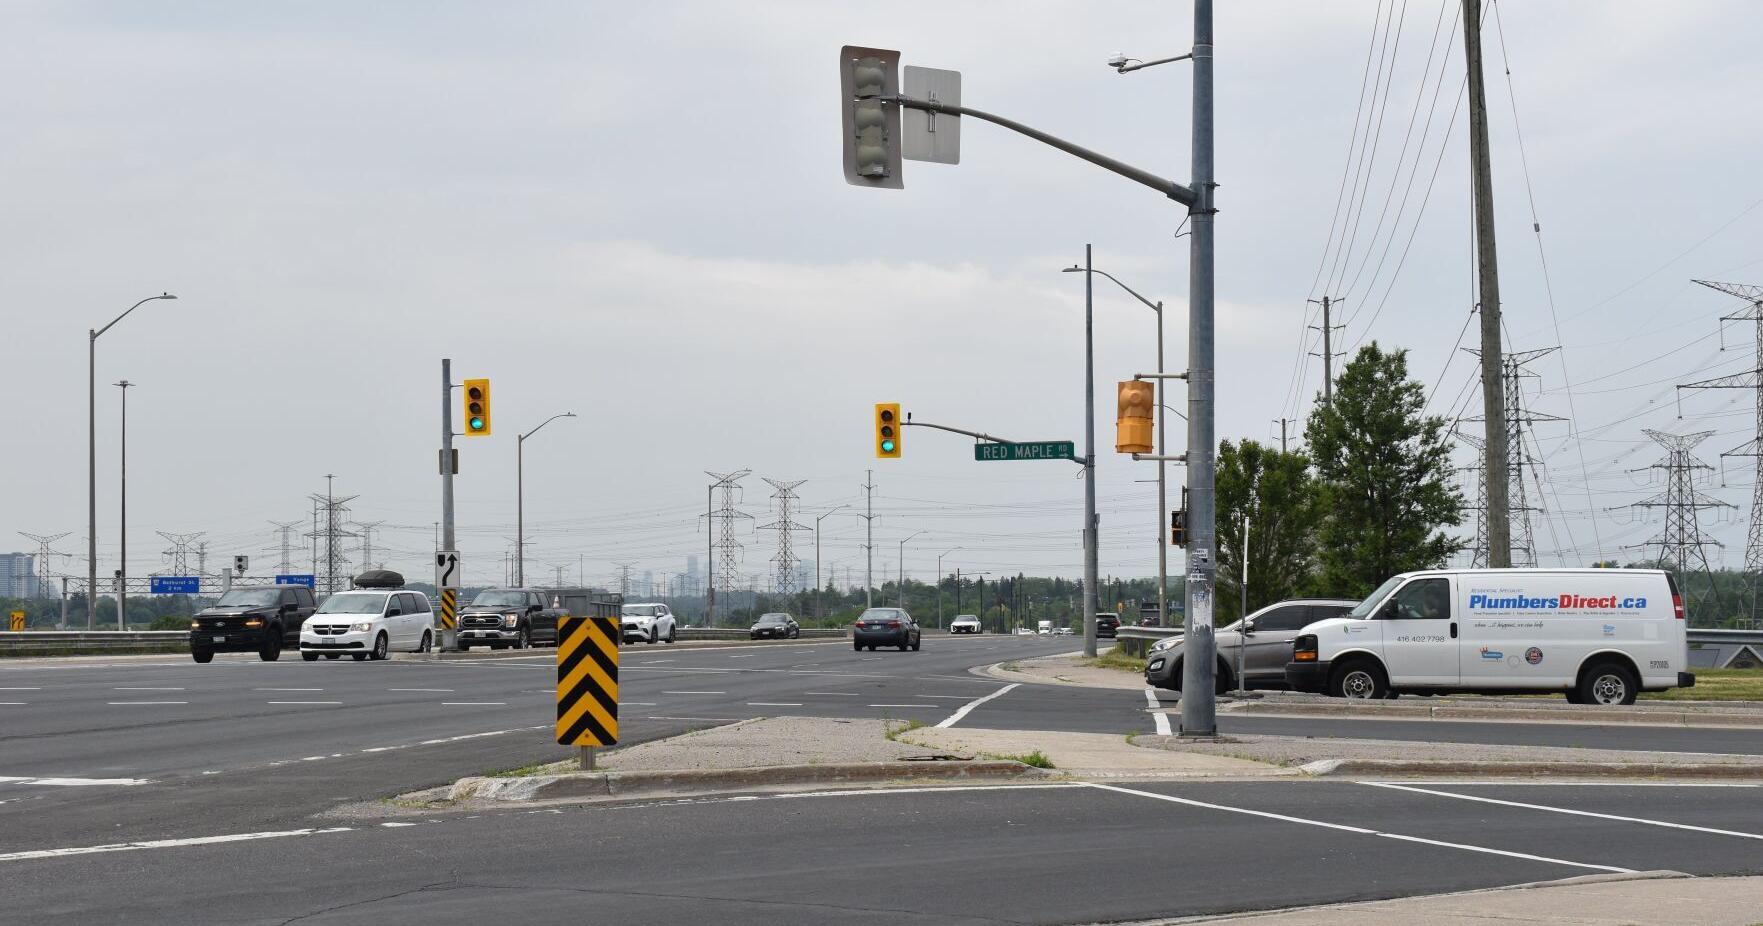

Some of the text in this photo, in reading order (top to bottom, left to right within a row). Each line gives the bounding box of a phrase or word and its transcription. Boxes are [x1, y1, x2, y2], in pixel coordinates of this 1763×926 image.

[983, 446, 1008, 459] RED
[1015, 444, 1053, 458] MAPLE
[1469, 594, 1647, 609] PlumbersDirect.ca
